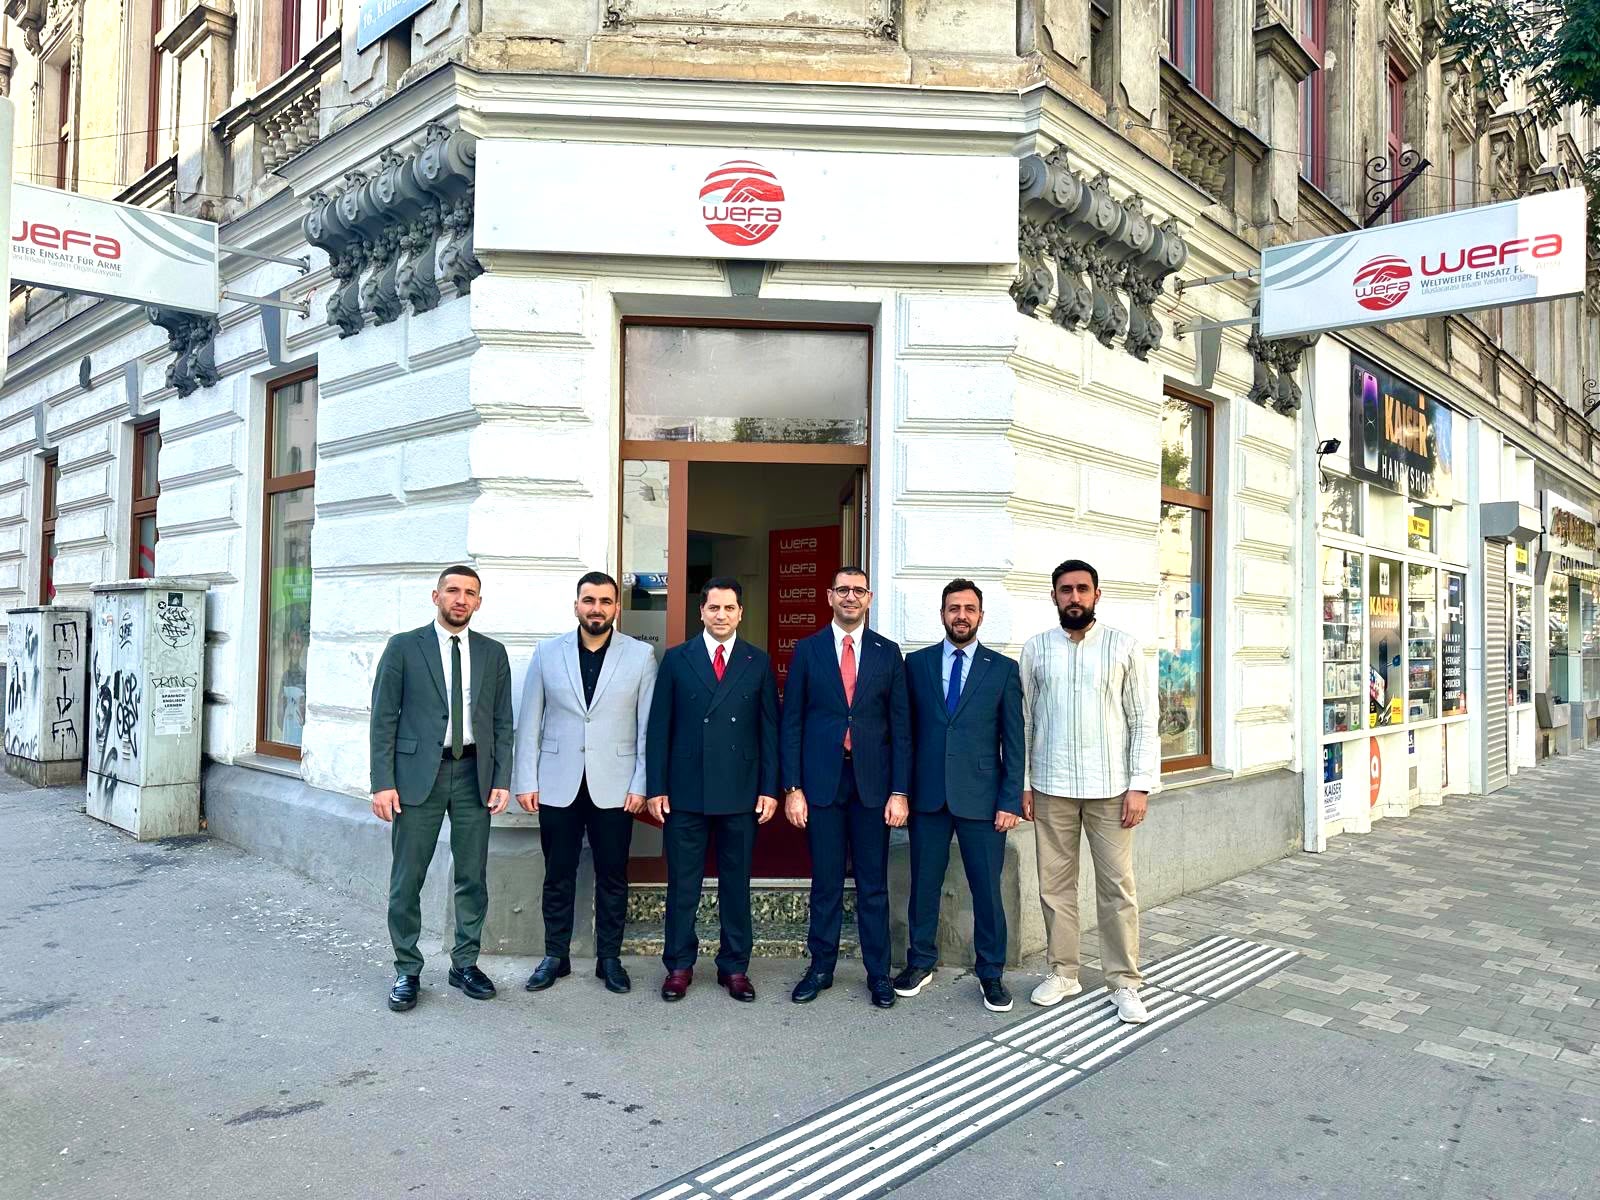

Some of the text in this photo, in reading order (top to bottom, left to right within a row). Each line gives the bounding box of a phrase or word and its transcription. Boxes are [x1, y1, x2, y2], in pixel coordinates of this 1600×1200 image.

[702, 205, 782, 223] wefa
[12, 244, 36, 256] EITER
[39, 248, 75, 263] EINSATZ
[97, 259, 122, 272] ARME
[1420, 233, 1563, 277] wefa
[1420, 274, 1473, 289] WELTWEITER
[1475, 267, 1511, 281] EINSATZ
[1355, 280, 1411, 298] wefa
[1383, 393, 1428, 458] KAISER
[779, 537, 817, 550] wefa
[779, 562, 817, 574] wefa
[779, 587, 816, 599] wefa
[1369, 596, 1399, 617] KAISER
[778, 613, 816, 624] wefa
